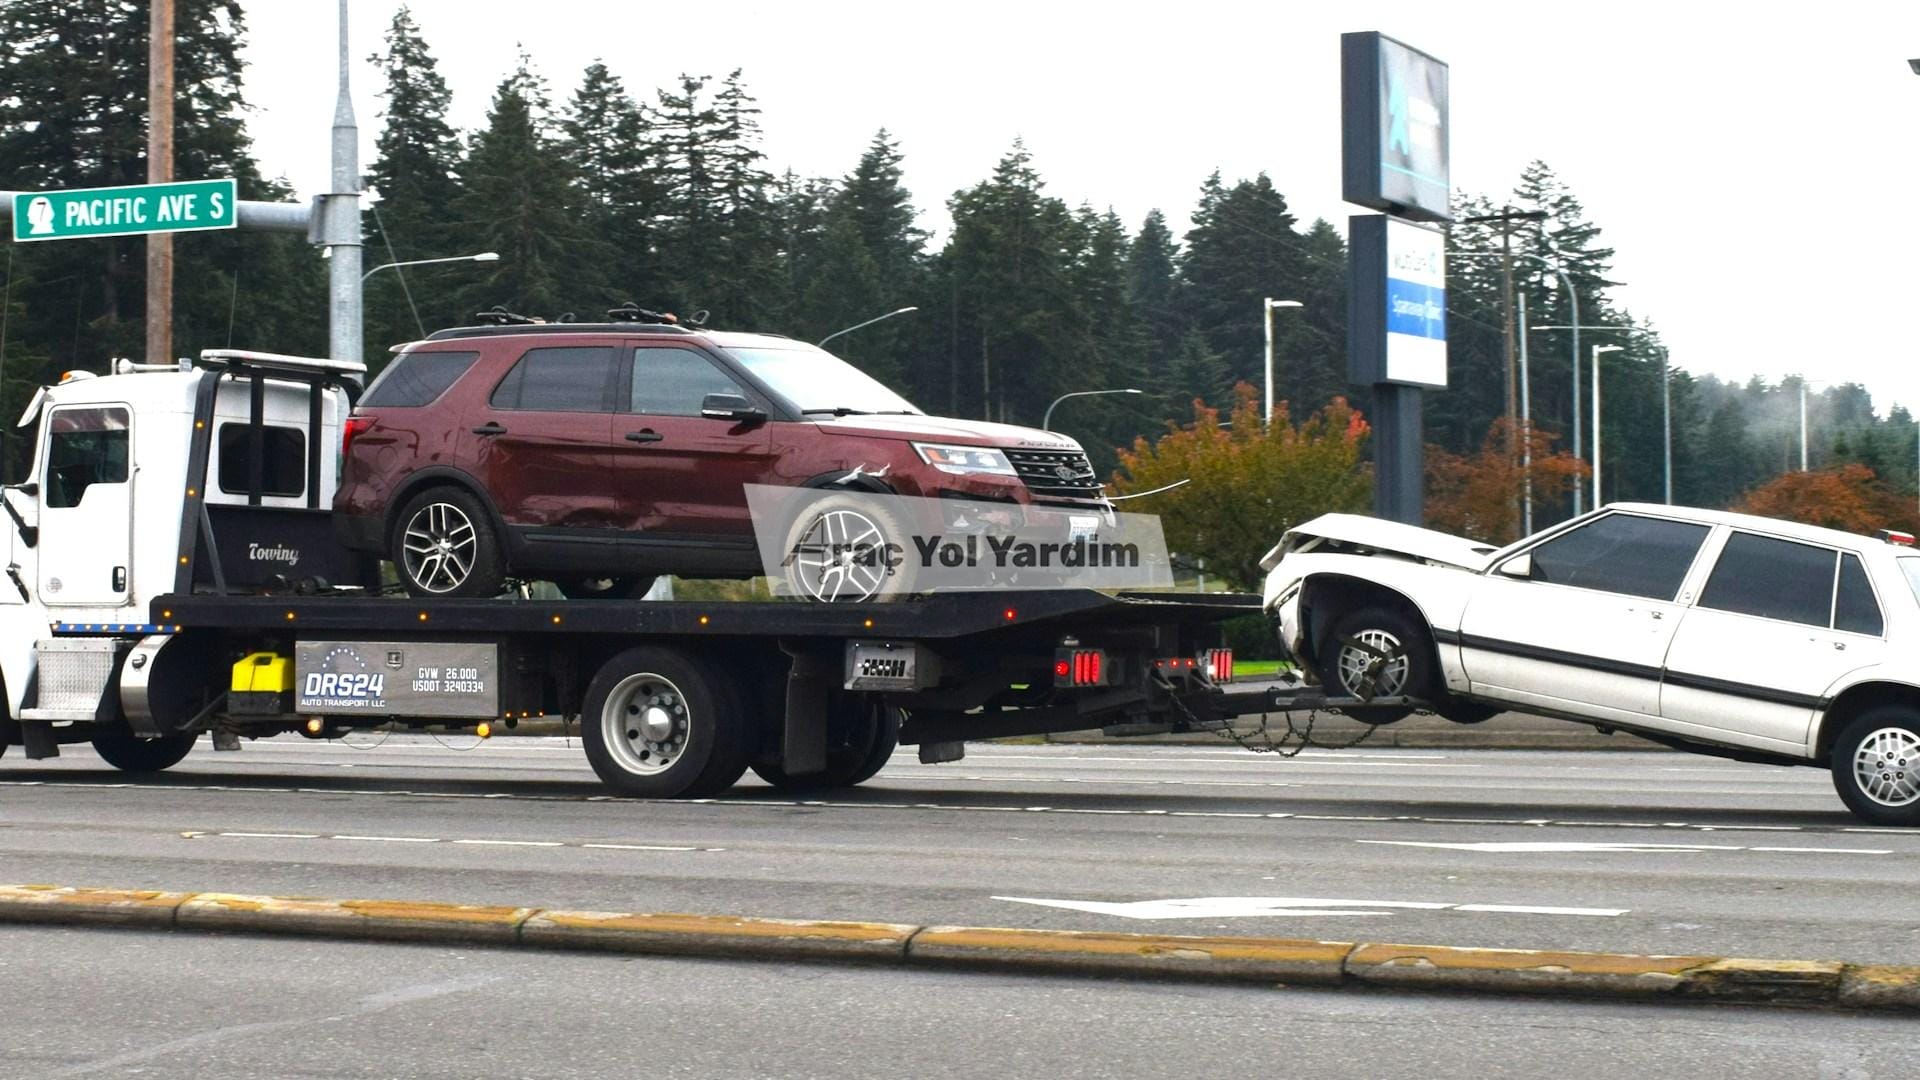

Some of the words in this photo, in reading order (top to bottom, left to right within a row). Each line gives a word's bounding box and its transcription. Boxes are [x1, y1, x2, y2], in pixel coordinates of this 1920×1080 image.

[66, 197, 147, 227] PACIFIC
[157, 194, 198, 222] AVE
[209, 192, 225, 219] S
[249, 543, 300, 566] Towing
[418, 667, 439, 679] GVW
[304, 672, 384, 698] DRS24
[444, 680, 484, 693] 3240334
[324, 699, 369, 707] TRANSPORT
